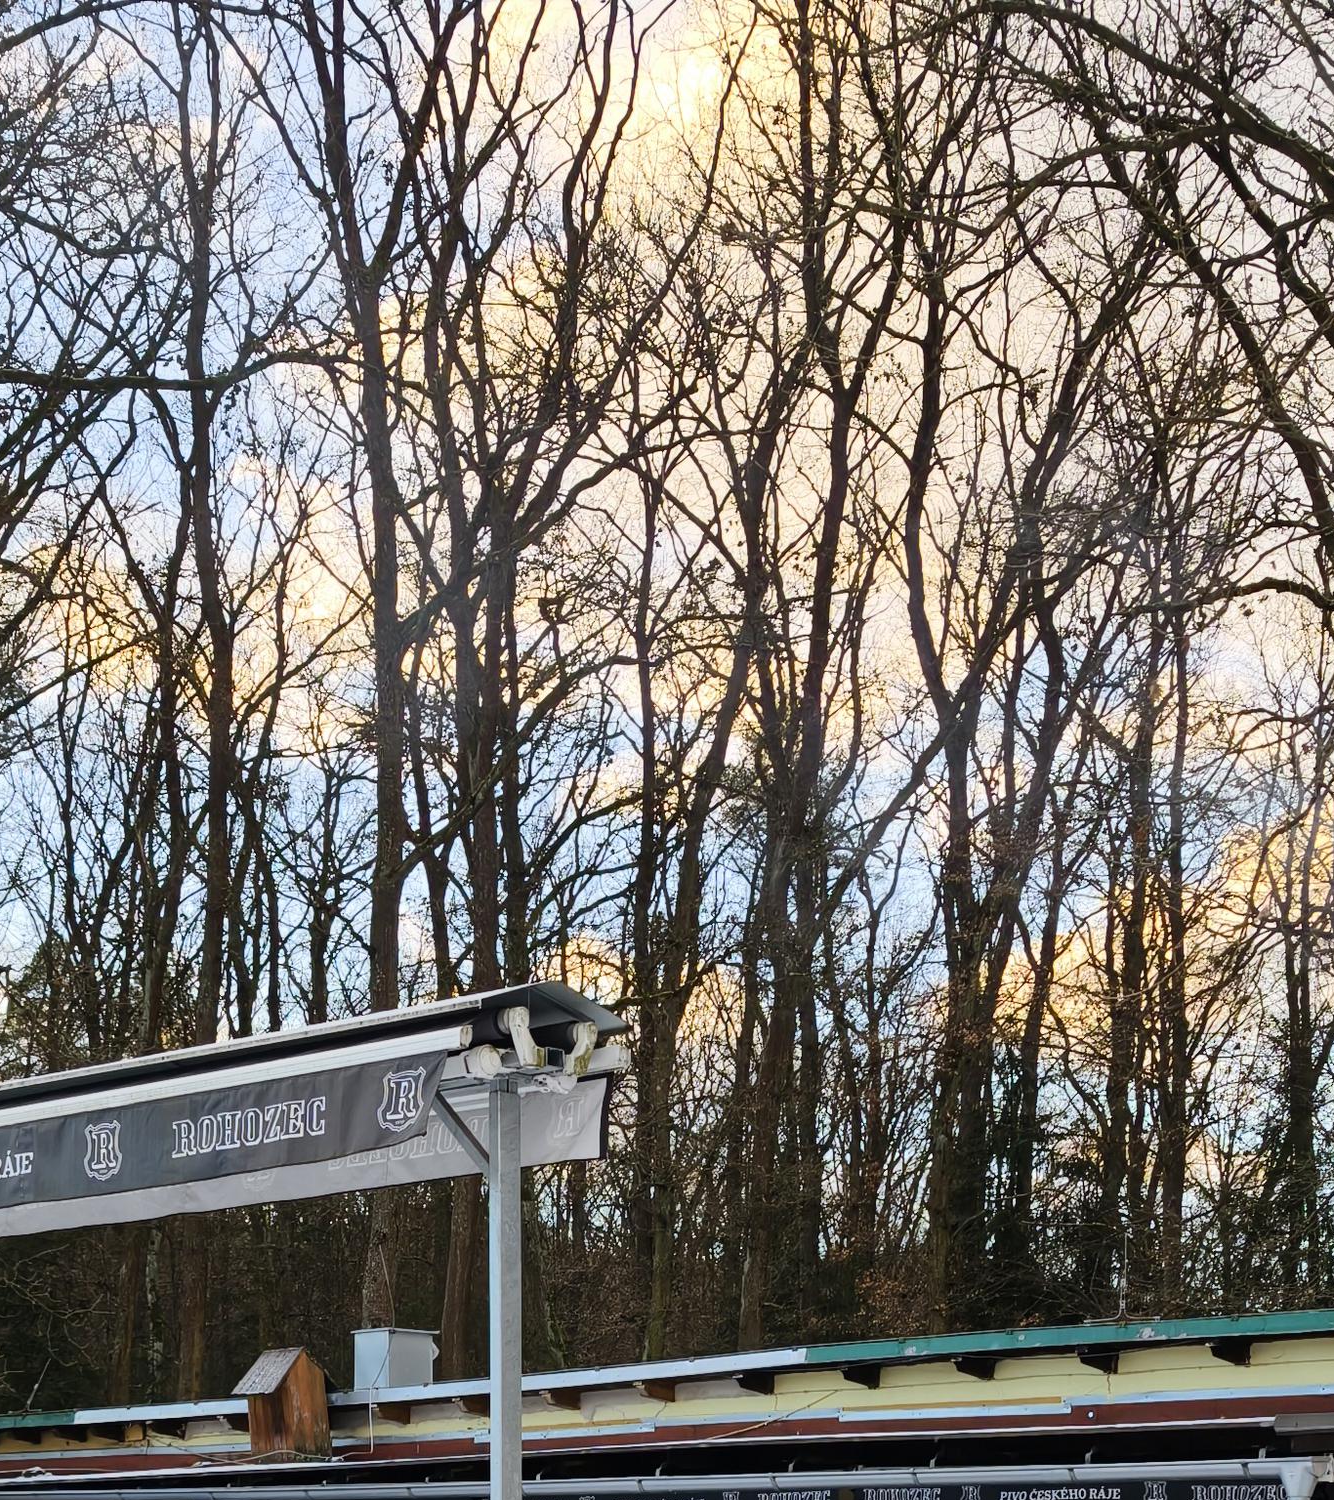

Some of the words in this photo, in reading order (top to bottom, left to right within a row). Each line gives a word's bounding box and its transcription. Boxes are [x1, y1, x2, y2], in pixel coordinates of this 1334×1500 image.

[171, 1096, 327, 1160] ROHOZEC
[1029, 1486, 1087, 1500] ČESKÉHO
[1089, 1485, 1122, 1500] RÁJE
